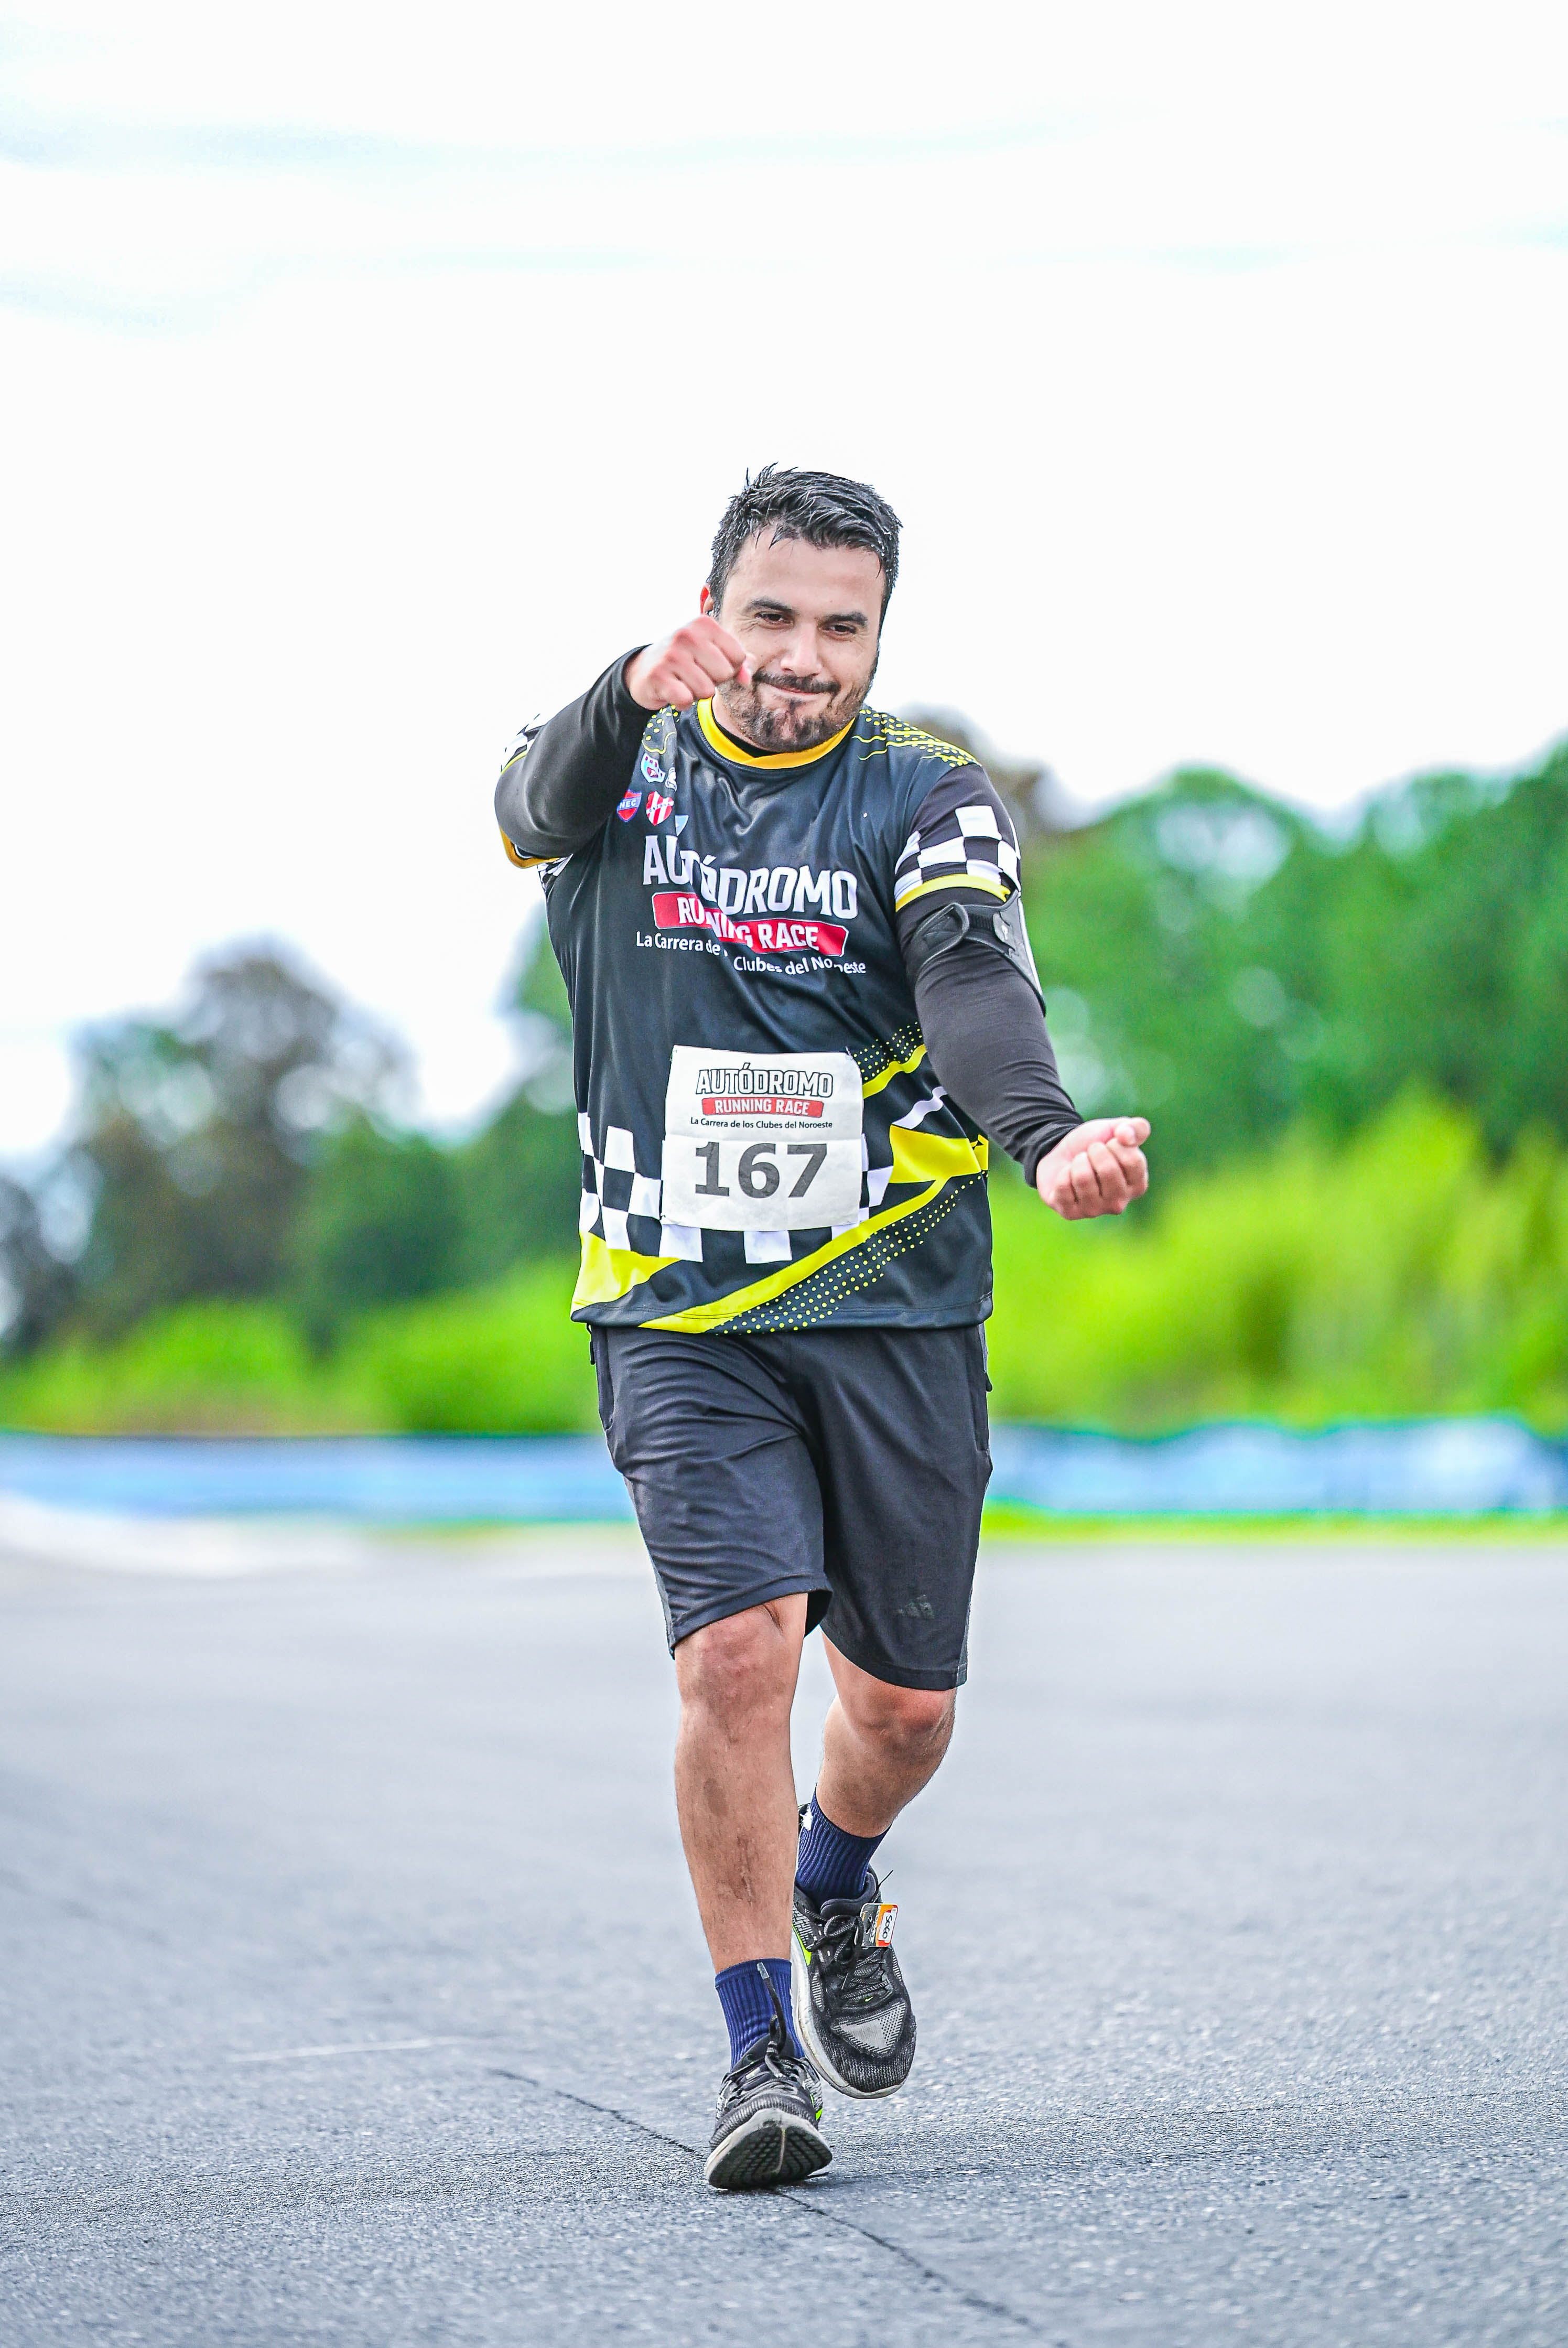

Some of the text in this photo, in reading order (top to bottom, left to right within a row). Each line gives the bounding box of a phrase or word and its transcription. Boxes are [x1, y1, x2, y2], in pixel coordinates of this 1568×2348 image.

[619, 799, 637, 809] NEC
[643, 835, 858, 919] AUTÓDROMO
[636, 931, 653, 947] La
[654, 932, 704, 952] Carrera
[706, 939, 721, 956] de
[733, 956, 783, 973] Clubes
[785, 957, 809, 975] del
[758, 923, 820, 951] RACE
[695, 1062, 834, 1098] AUTÓDROMO
[714, 1098, 810, 1115] RUNNING RACE
[690, 1117, 699, 1125] La
[700, 1118, 728, 1128] Carrera
[730, 1120, 741, 1128] de
[742, 1120, 754, 1128] los
[756, 1121, 783, 1129] Clubes
[784, 1121, 797, 1129] del
[695, 1141, 827, 1199] 167
